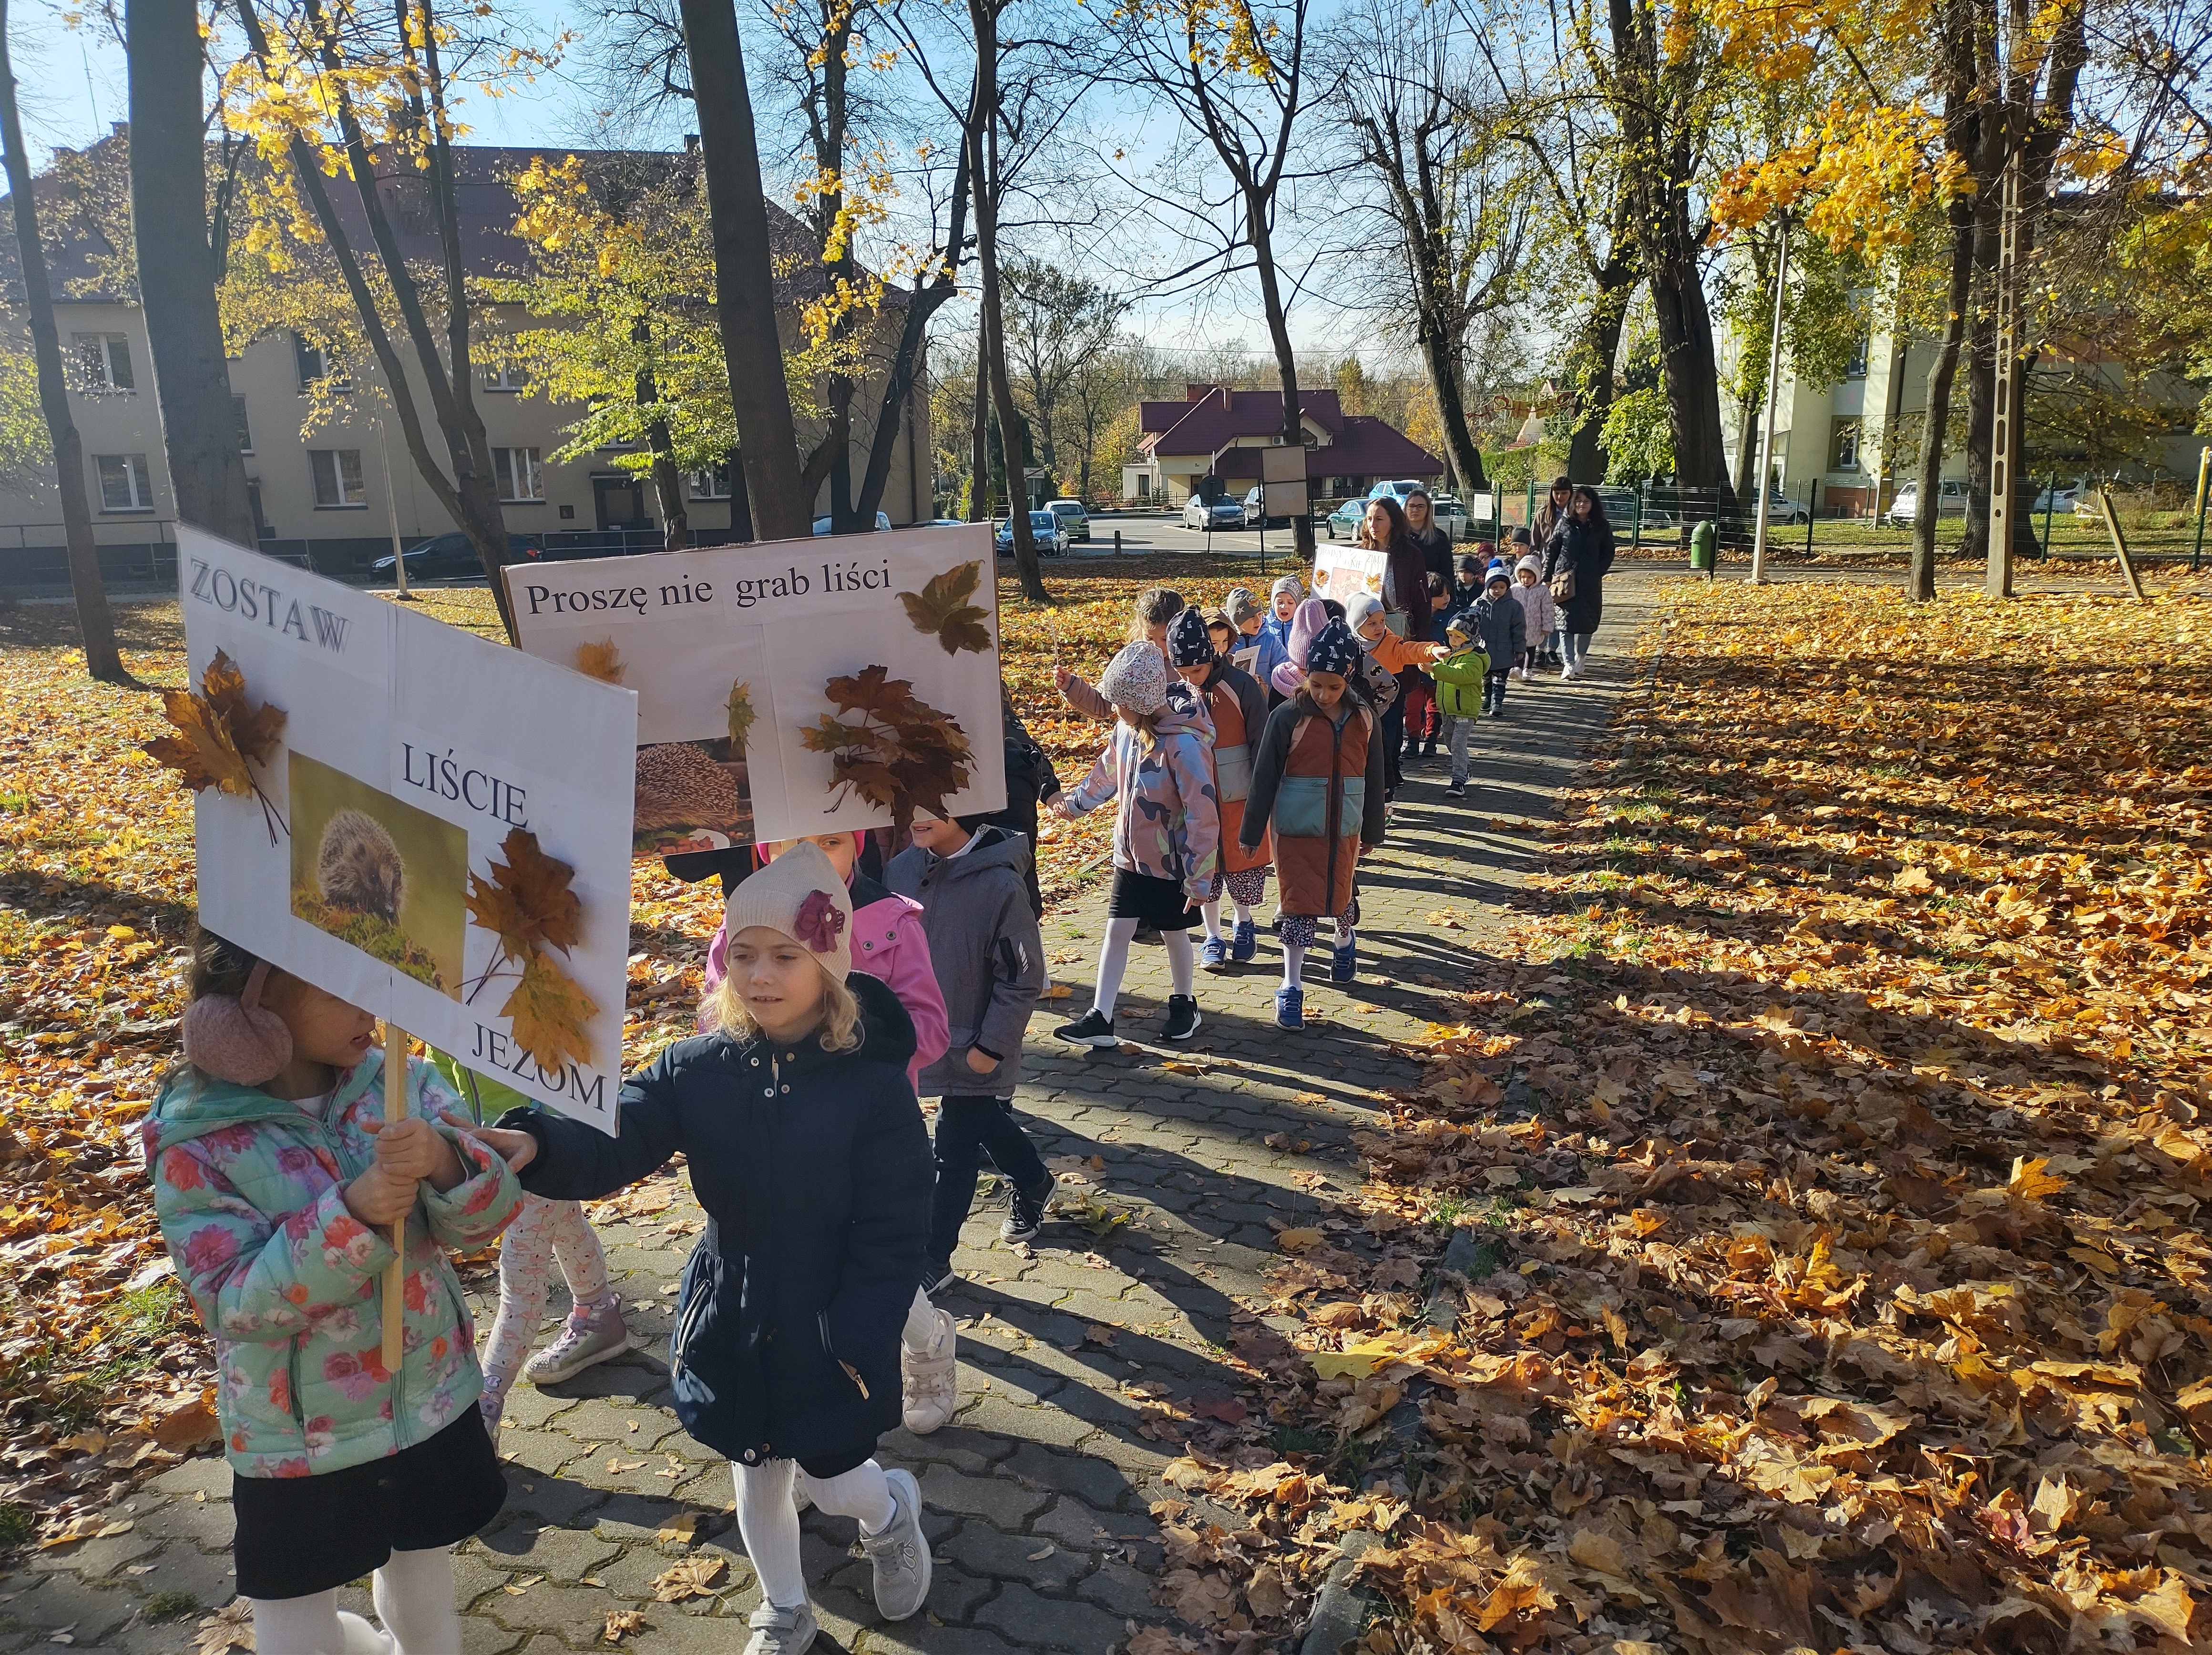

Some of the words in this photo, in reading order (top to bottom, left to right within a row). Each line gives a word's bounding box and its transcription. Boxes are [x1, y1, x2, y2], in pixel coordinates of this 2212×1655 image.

[190, 555, 353, 654] ZOSTAW
[524, 585, 648, 615] Proszę
[659, 574, 713, 606] nie
[736, 567, 810, 608] grab
[821, 559, 893, 593] liści
[402, 742, 529, 828] LIŚCIE
